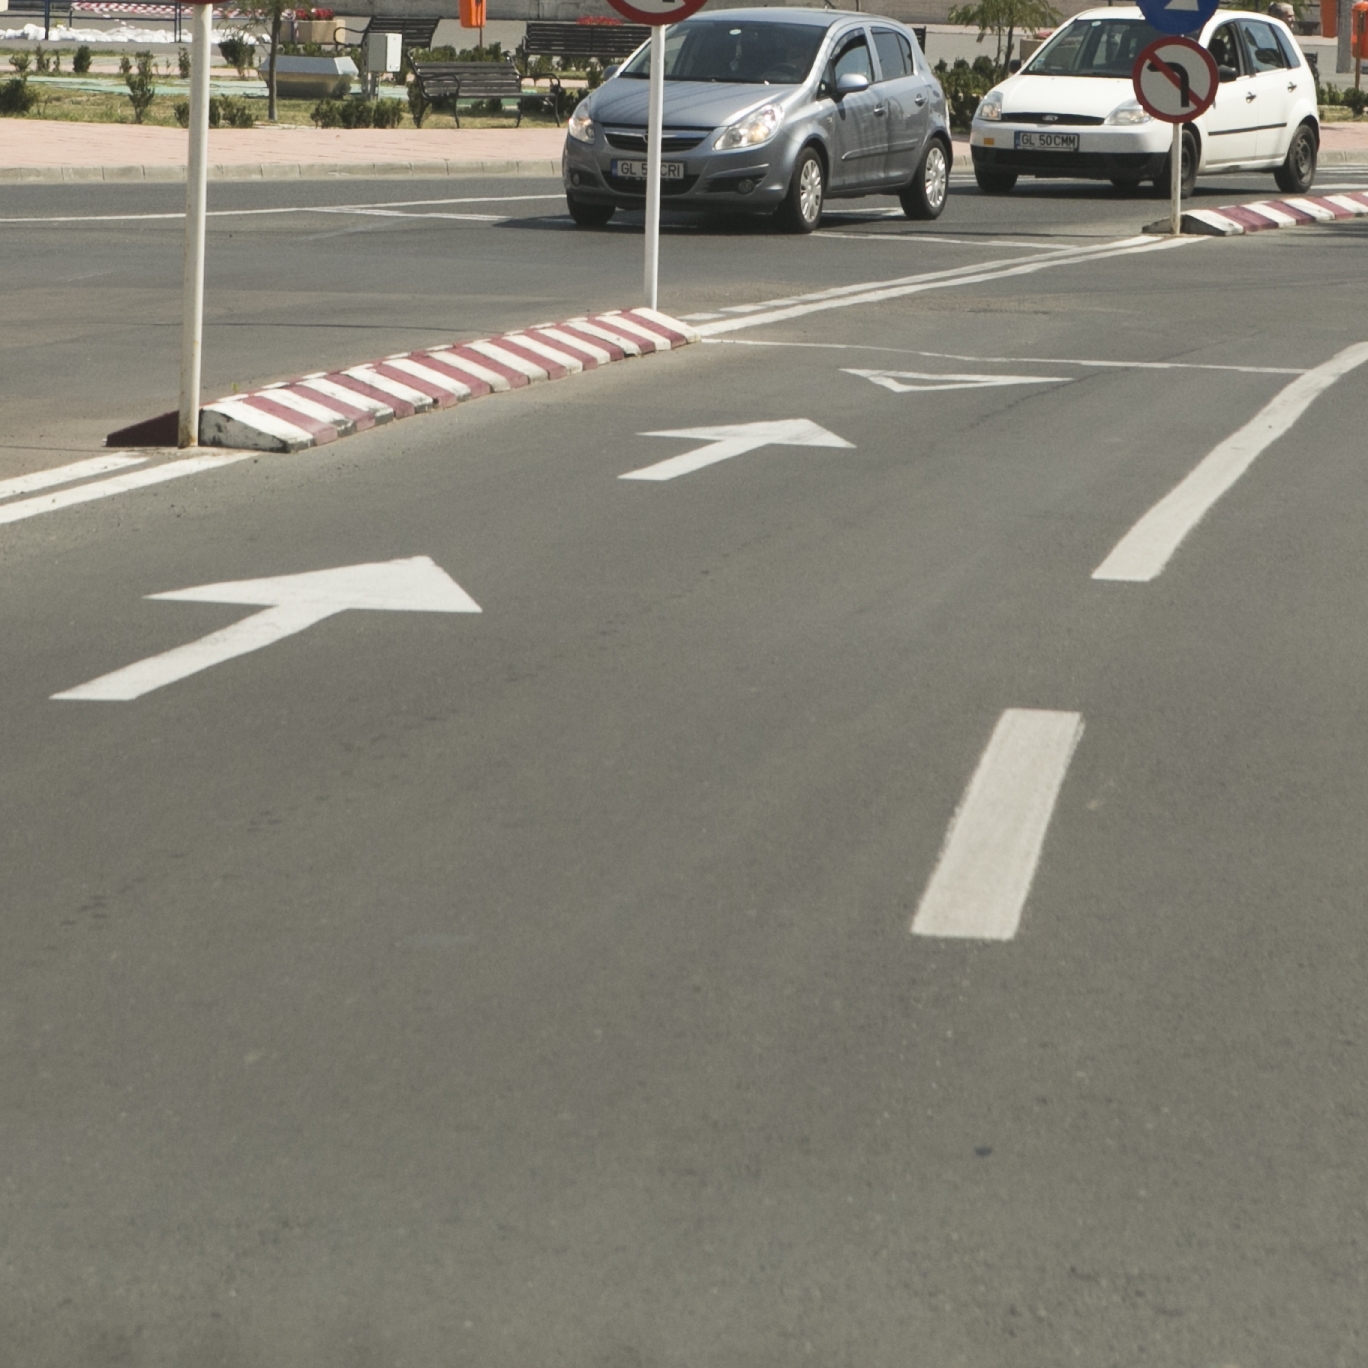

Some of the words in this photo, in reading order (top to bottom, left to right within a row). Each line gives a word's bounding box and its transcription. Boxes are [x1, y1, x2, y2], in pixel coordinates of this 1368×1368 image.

[1022, 134, 1035, 146] GL
[621, 162, 637, 175] GL
[660, 164, 680, 177] CRI
